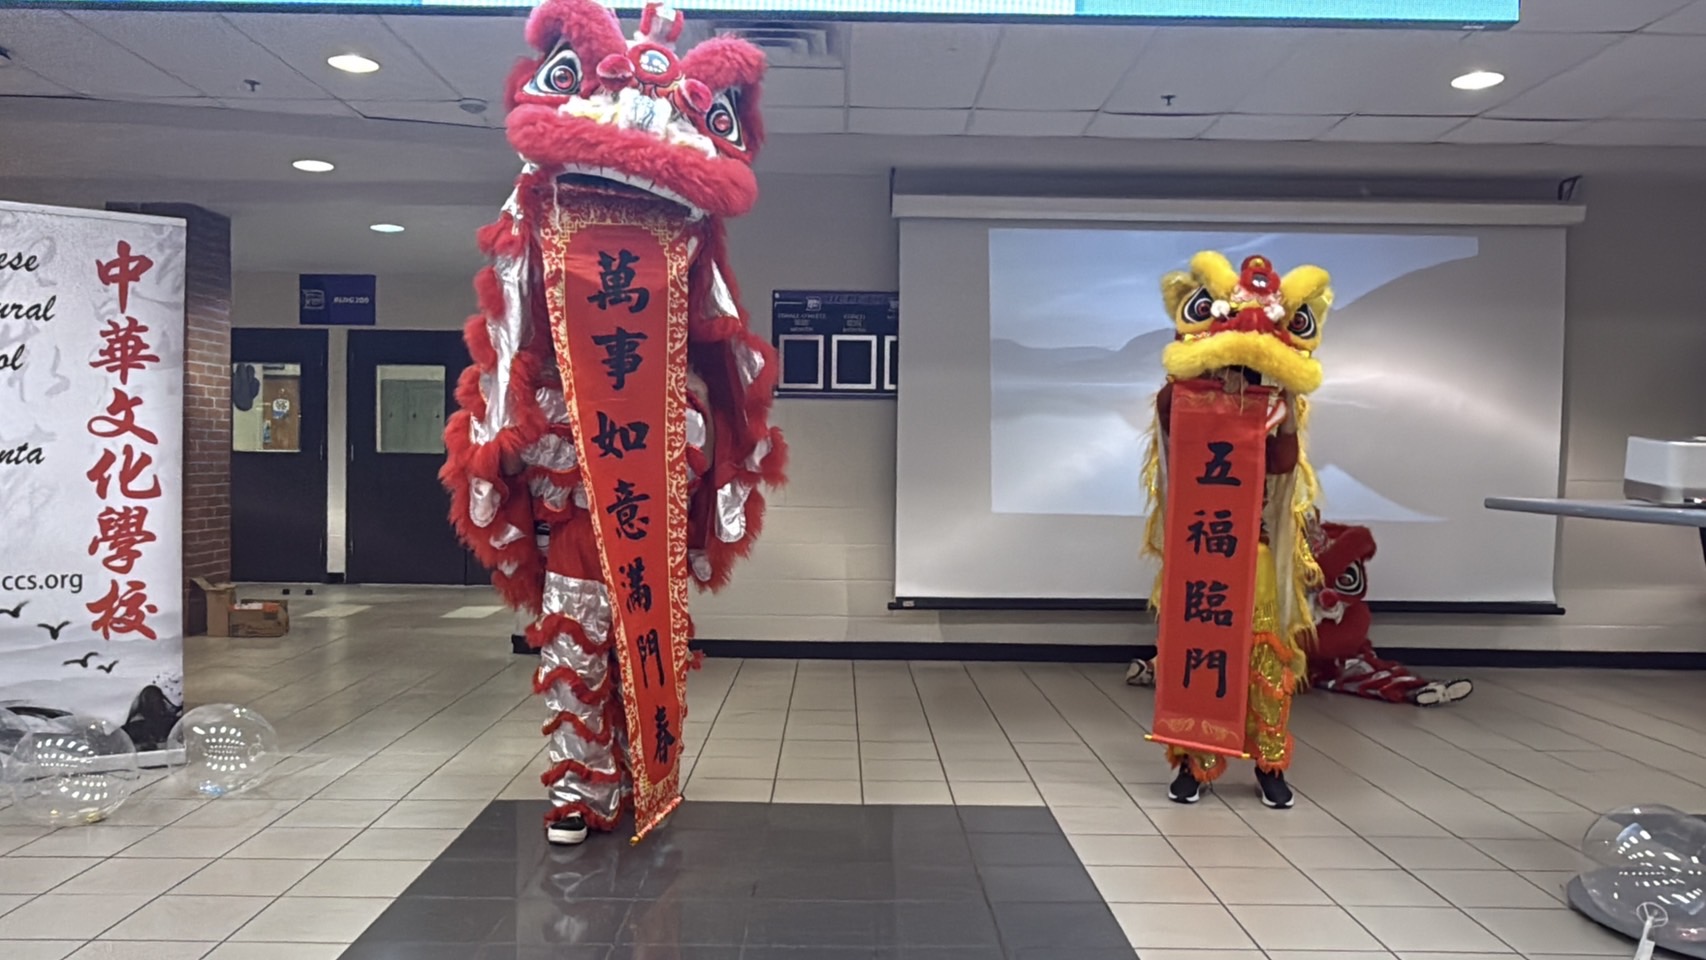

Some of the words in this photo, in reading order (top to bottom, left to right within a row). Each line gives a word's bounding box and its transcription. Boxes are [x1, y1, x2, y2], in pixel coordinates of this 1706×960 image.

[86, 240, 162, 640] 中華文化學校
[2, 573, 83, 594] ccs.org
[1182, 441, 1241, 698] 五福臨門
